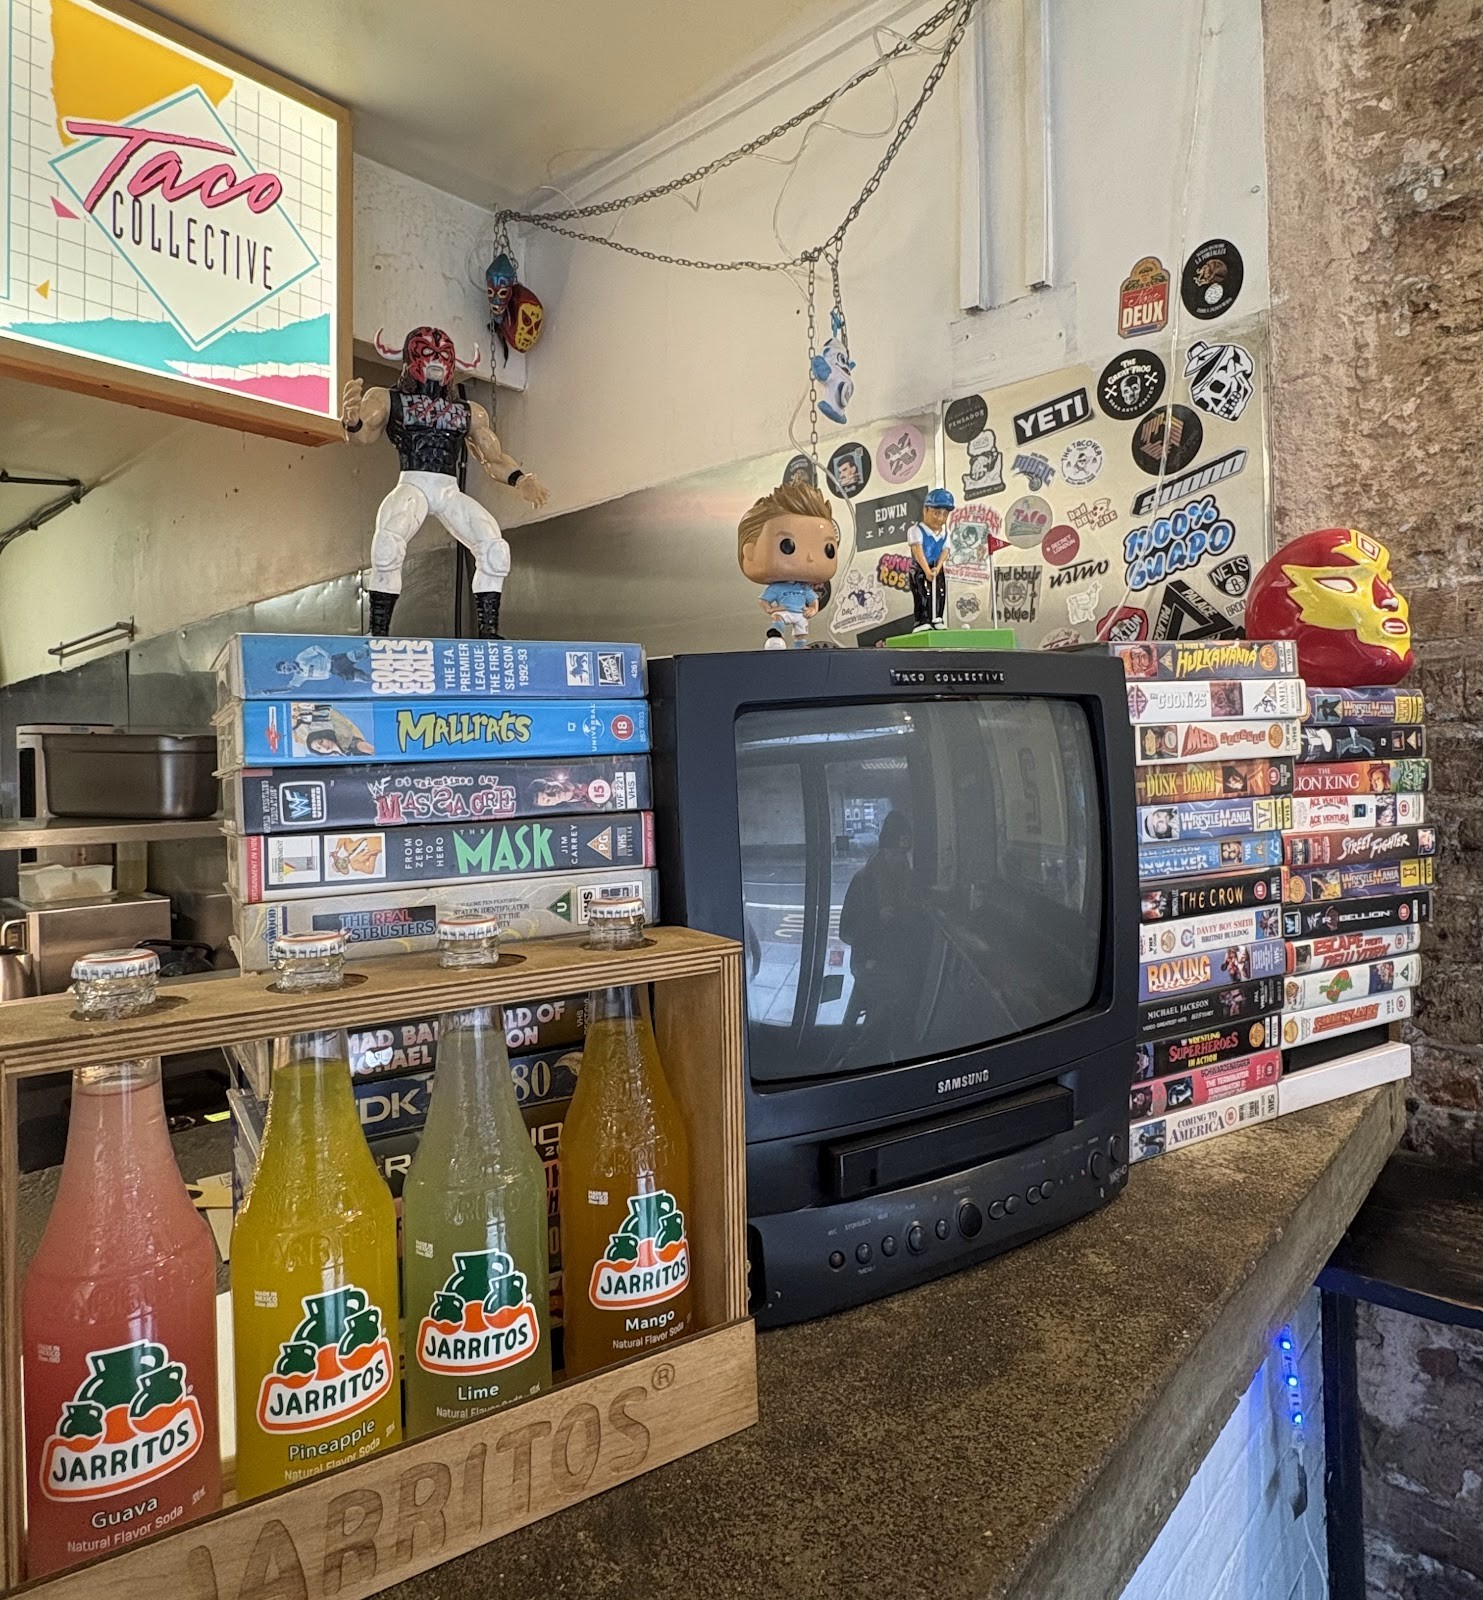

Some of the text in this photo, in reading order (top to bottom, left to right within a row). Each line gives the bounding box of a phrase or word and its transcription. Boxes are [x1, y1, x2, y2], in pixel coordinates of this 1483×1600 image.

[66, 121, 282, 214] Taco
[113, 190, 272, 290] COLLECTIVE
[1122, 300, 1164, 329] DEUX
[1107, 368, 1131, 384] GREAT
[948, 409, 985, 429] PENSADOR
[1017, 395, 1084, 437] YETI
[1061, 440, 1102, 462] THE TACOVER
[875, 503, 907, 522] EDWIN
[1014, 508, 1047, 525] TACO
[1051, 535, 1071, 549] SECRET
[1053, 540, 1076, 554] LONDON
[1128, 524, 1229, 586] GUAPO
[880, 567, 908, 589] ROS
[1212, 556, 1249, 586] NETS
[1231, 578, 1240, 592] B
[1181, 590, 1217, 618] PALACE
[1226, 599, 1246, 616] BROO
[369, 640, 394, 694] GOALS
[389, 640, 415, 694] GOALS
[411, 641, 436, 694] GOALS
[444, 646, 455, 689] THE F.A.
[458, 643, 470, 692] PREMIER
[474, 645, 485, 690] LEAGUE:
[488, 642, 500, 694] THE FIRST
[503, 645, 515, 691] SEASON
[519, 648, 529, 687] 1992-93
[600, 660, 611, 681] FOX
[1176, 647, 1257, 678] HULKAMANIA
[896, 673, 1004, 682] TACO COLLECTIVE
[617, 721, 628, 734] 18
[1181, 724, 1219, 757] MEGA
[594, 786, 605, 798] 15
[617, 780, 625, 809] WF 221
[1146, 770, 1216, 797] DUSK DAWN
[1325, 773, 1360, 790] KING
[374, 786, 516, 826] MASSACRE
[1310, 797, 1322, 809] ACE
[1323, 796, 1349, 806] VENTURA
[460, 828, 485, 836] THE
[1310, 813, 1350, 827] ACE VENTURA
[404, 837, 413, 870] FROM
[415, 838, 424, 868] ZERO
[426, 845, 434, 860] TO
[436, 837, 444, 867] HERO
[452, 823, 555, 874] MASK
[561, 836, 569, 854] JIM
[597, 834, 609, 851] PG
[1337, 832, 1374, 860] STREET
[1369, 832, 1411, 859] FIGHTER
[481, 903, 530, 913] IDENTIFICATION
[557, 902, 568, 912] U
[1180, 885, 1244, 912] THE CROW
[340, 910, 412, 928] THE REAL
[350, 920, 435, 941] STBUSTERS
[1196, 918, 1253, 936] DAVEY BOY SMITH
[1201, 929, 1249, 943] BRITISH BULLDOG
[1313, 933, 1364, 957] ESCAPE
[1147, 955, 1211, 993] BOXING
[1153, 975, 1209, 992] CRAZY
[537, 1001, 565, 1023] OF
[1147, 999, 1209, 1020] MICHAEL JACKSON
[506, 1026, 539, 1048] ON
[1169, 1032, 1238, 1062] SUPERHEROES
[1188, 1032, 1220, 1045] WRESTLING
[1196, 1054, 1217, 1065] ACTION
[511, 1061, 551, 1101] 80
[937, 1069, 989, 1094] SAMSUNG
[1217, 1070, 1249, 1084] TERMINATOR
[355, 1088, 422, 1125] DK
[1178, 1111, 1217, 1128] COMING TO
[1169, 1116, 1225, 1145] AMERICA
[600, 1257, 686, 1295] JARRITOS
[625, 1309, 675, 1332] Mango
[426, 1323, 527, 1360] JARRITOS
[613, 1322, 684, 1349] Natural Flavor Soda
[270, 1359, 383, 1416] JARRITOS
[458, 1385, 499, 1401] Lime
[437, 1406, 468, 1419] Natural
[53, 1419, 190, 1483] JARRITOS
[288, 1419, 376, 1462] Pineapple
[284, 1462, 324, 1482] Natural
[359, 1436, 381, 1457] Soda
[91, 1496, 159, 1530] Guava
[67, 1504, 184, 1554] Natural Flavor Soda
